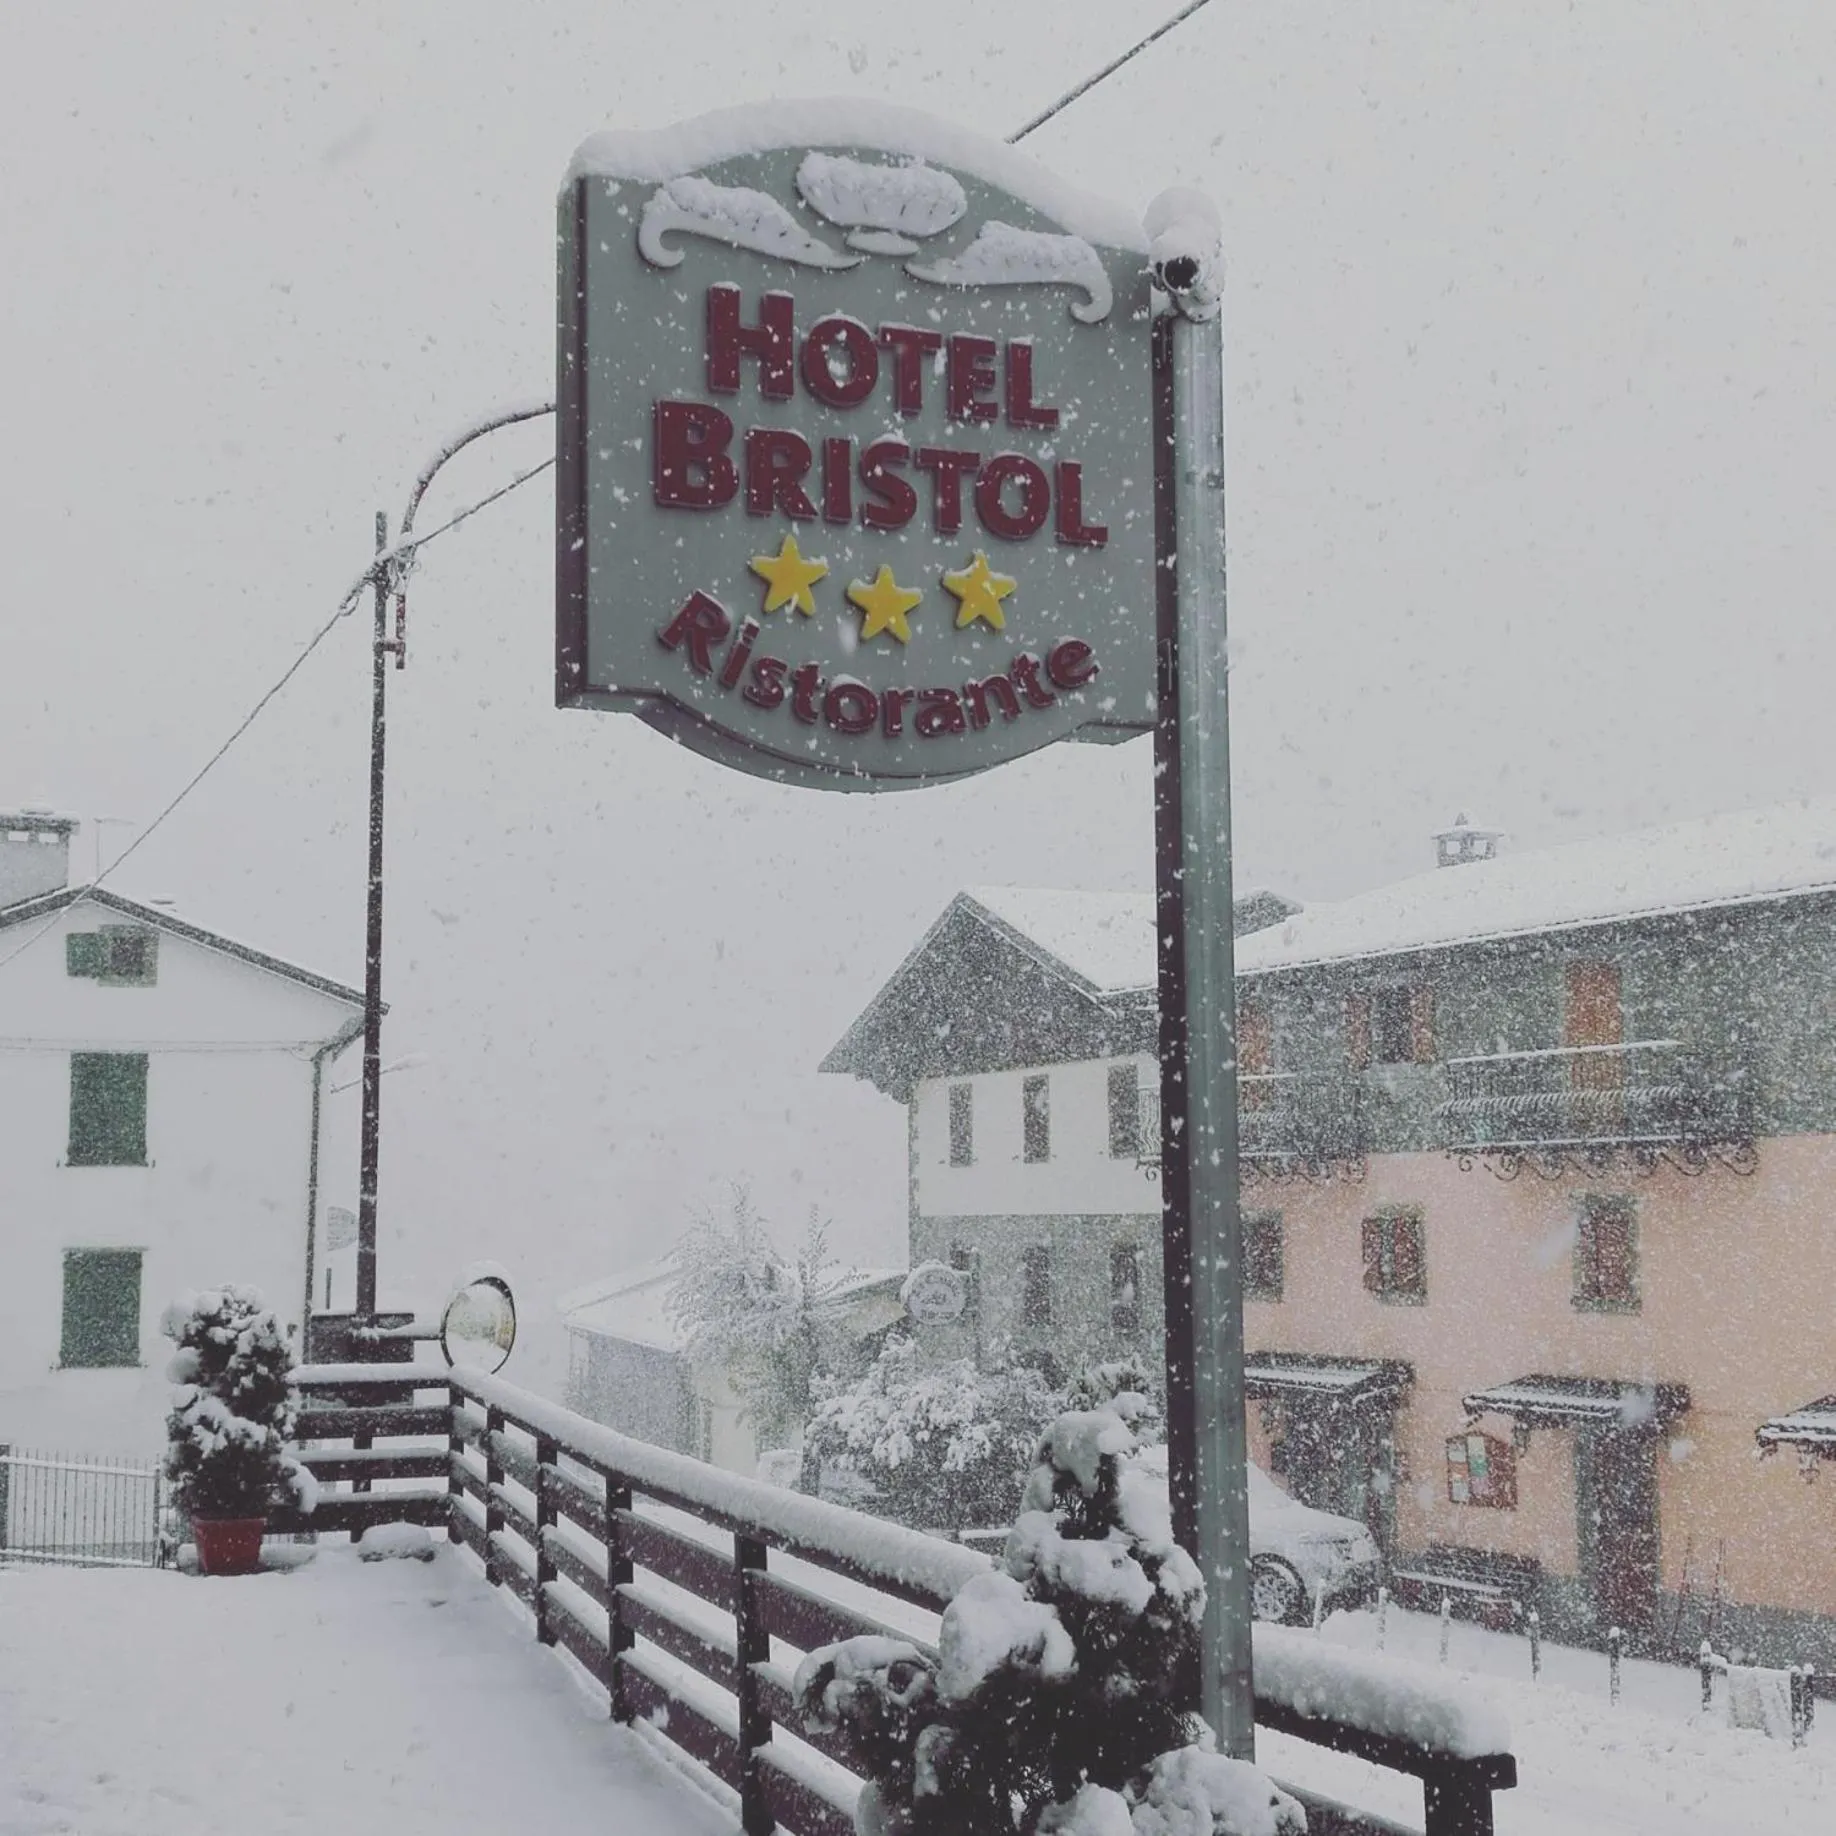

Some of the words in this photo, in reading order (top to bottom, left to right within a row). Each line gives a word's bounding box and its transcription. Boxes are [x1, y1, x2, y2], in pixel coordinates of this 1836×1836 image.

[708, 283, 1059, 427] HOTEL
[654, 398, 1108, 546] BRISTOL
[659, 589, 1100, 737] Ristorante
